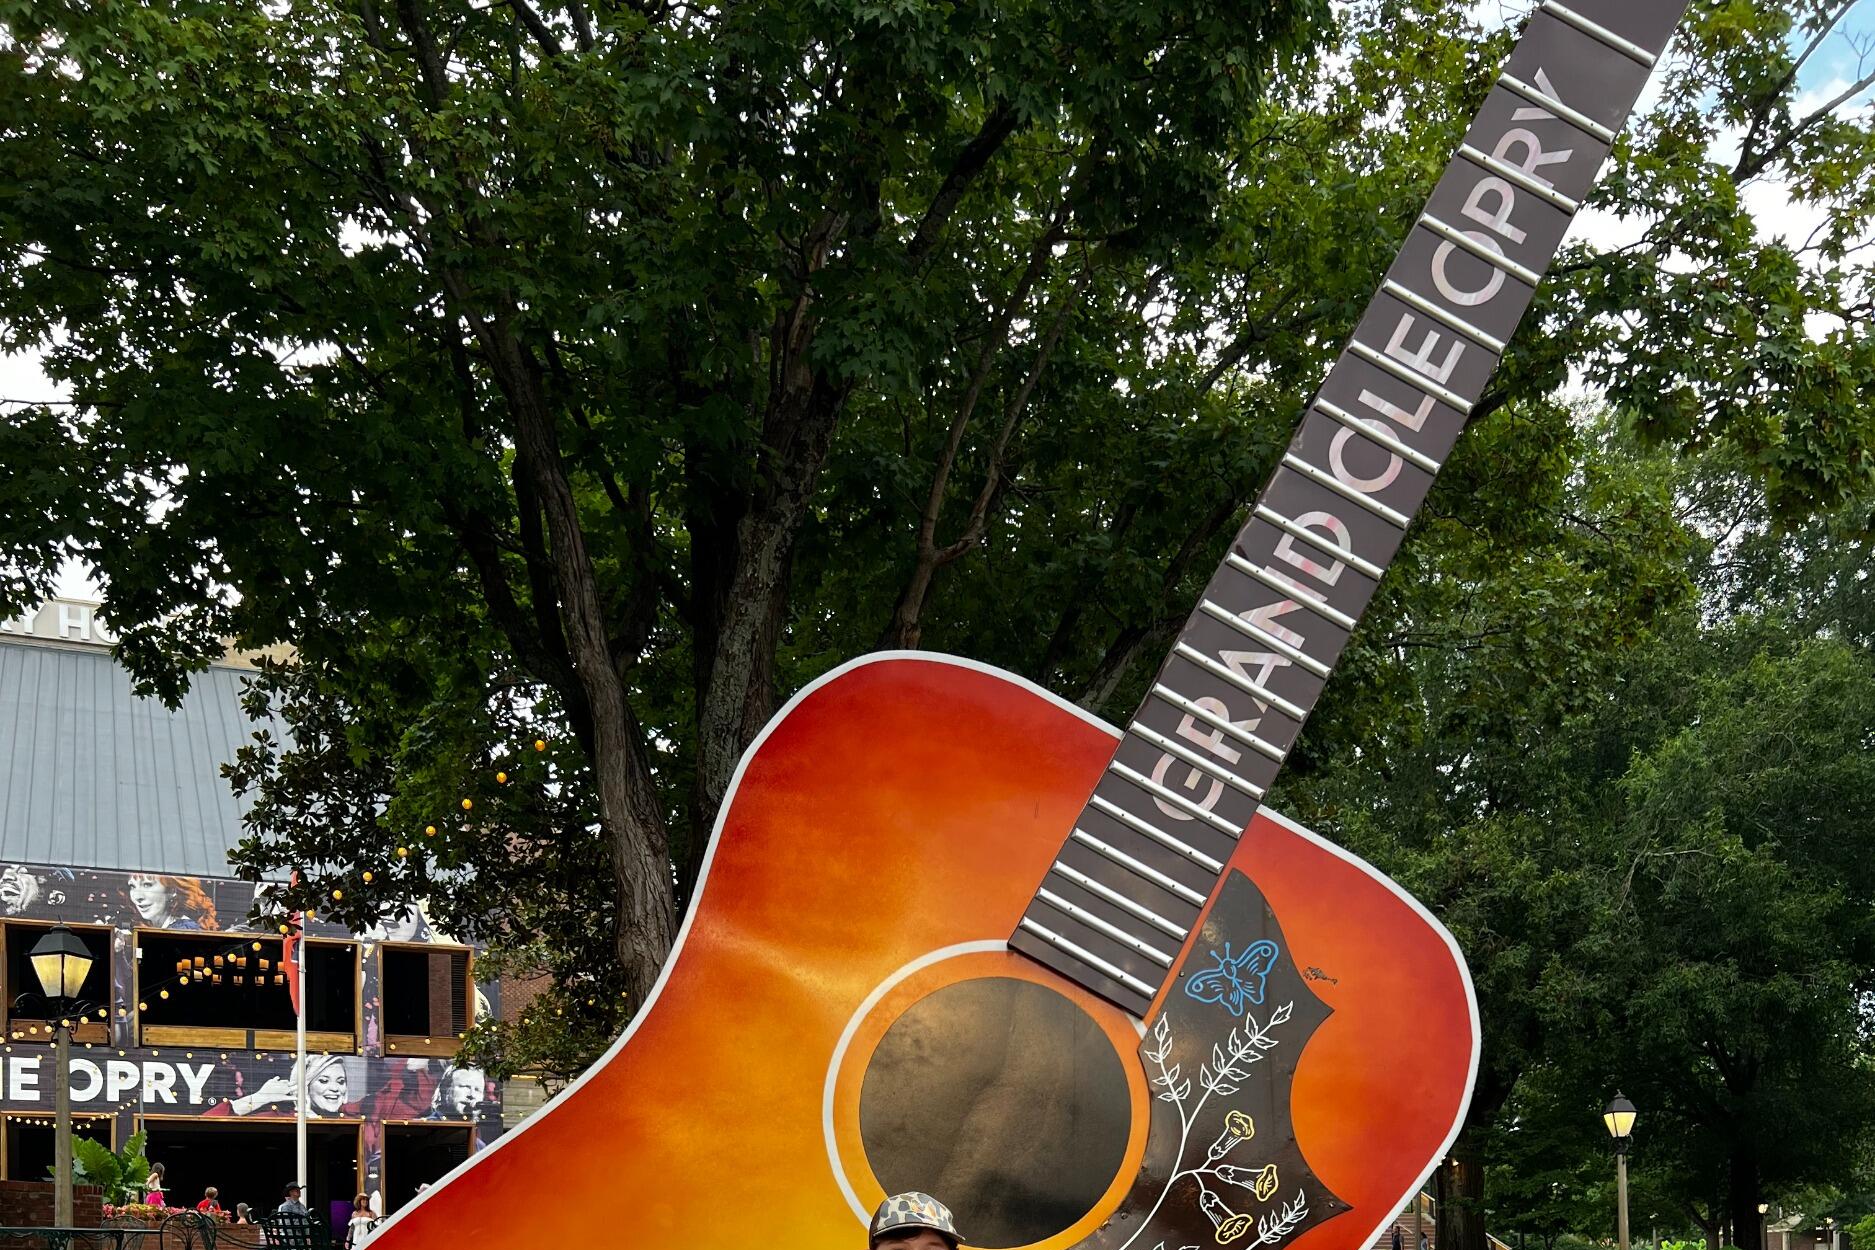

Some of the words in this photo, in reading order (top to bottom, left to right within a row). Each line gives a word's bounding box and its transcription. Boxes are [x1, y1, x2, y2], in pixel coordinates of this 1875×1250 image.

[1152, 510, 1353, 821] GRAND
[1329, 314, 1467, 493] OLE
[1431, 66, 1574, 307] OPRY
